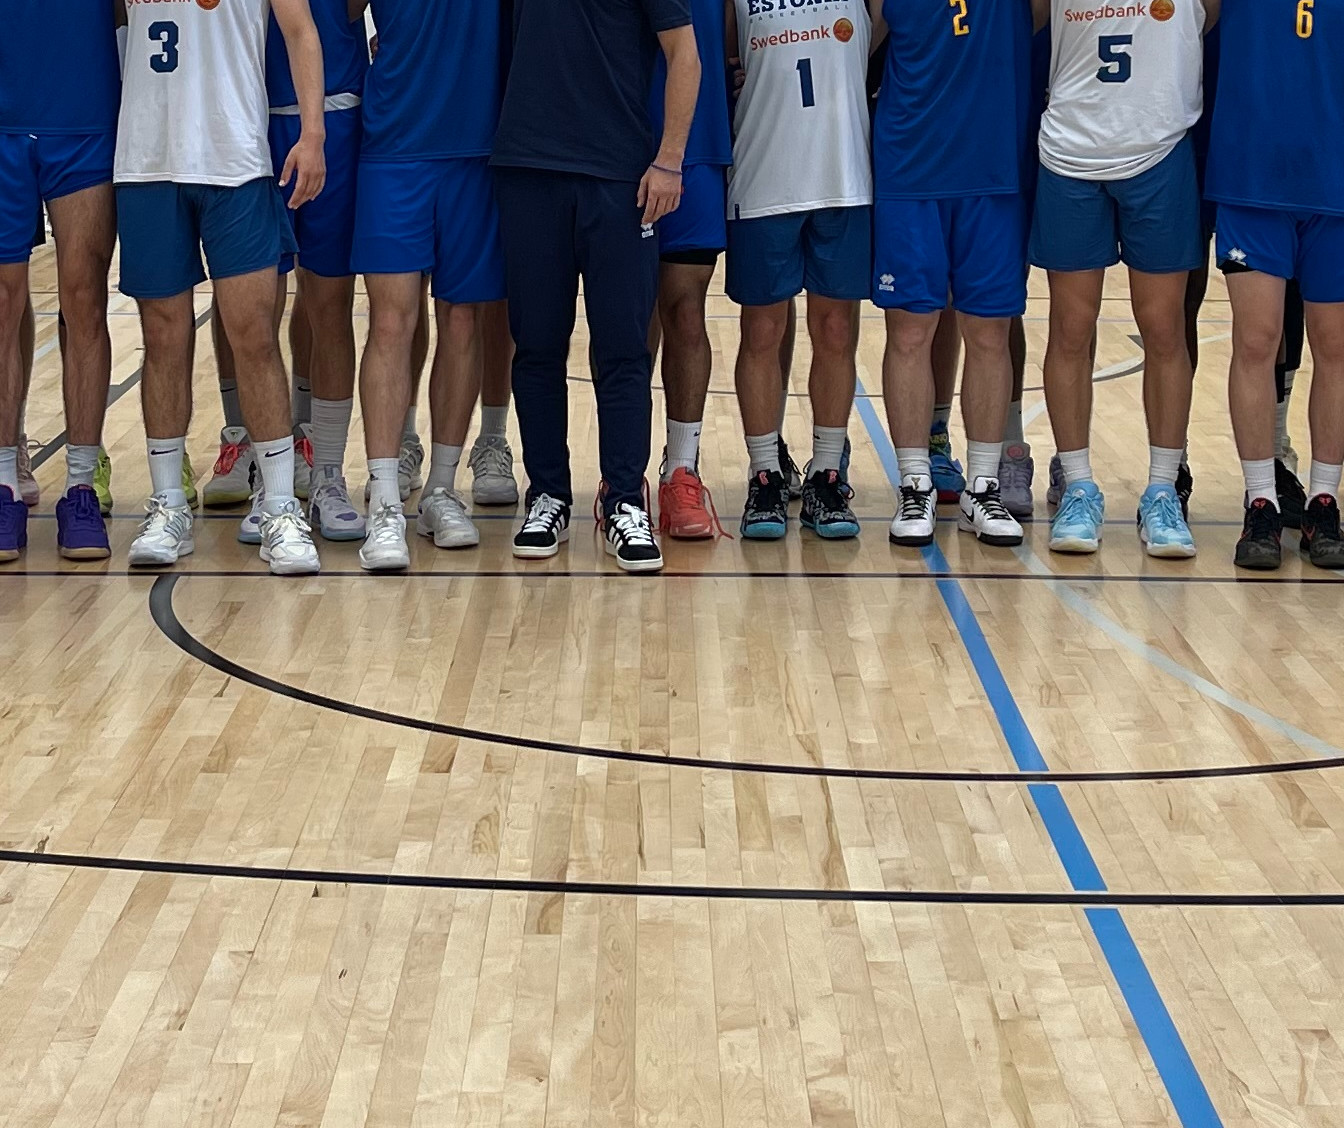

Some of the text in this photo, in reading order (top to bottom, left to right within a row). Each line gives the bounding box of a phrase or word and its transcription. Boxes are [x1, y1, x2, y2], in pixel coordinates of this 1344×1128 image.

[1064, 2, 1147, 22] Swedbank
[148, 21, 179, 73] 3
[750, 24, 831, 51] Swedbank
[1095, 34, 1133, 83] 5
[795, 57, 815, 108] 1
